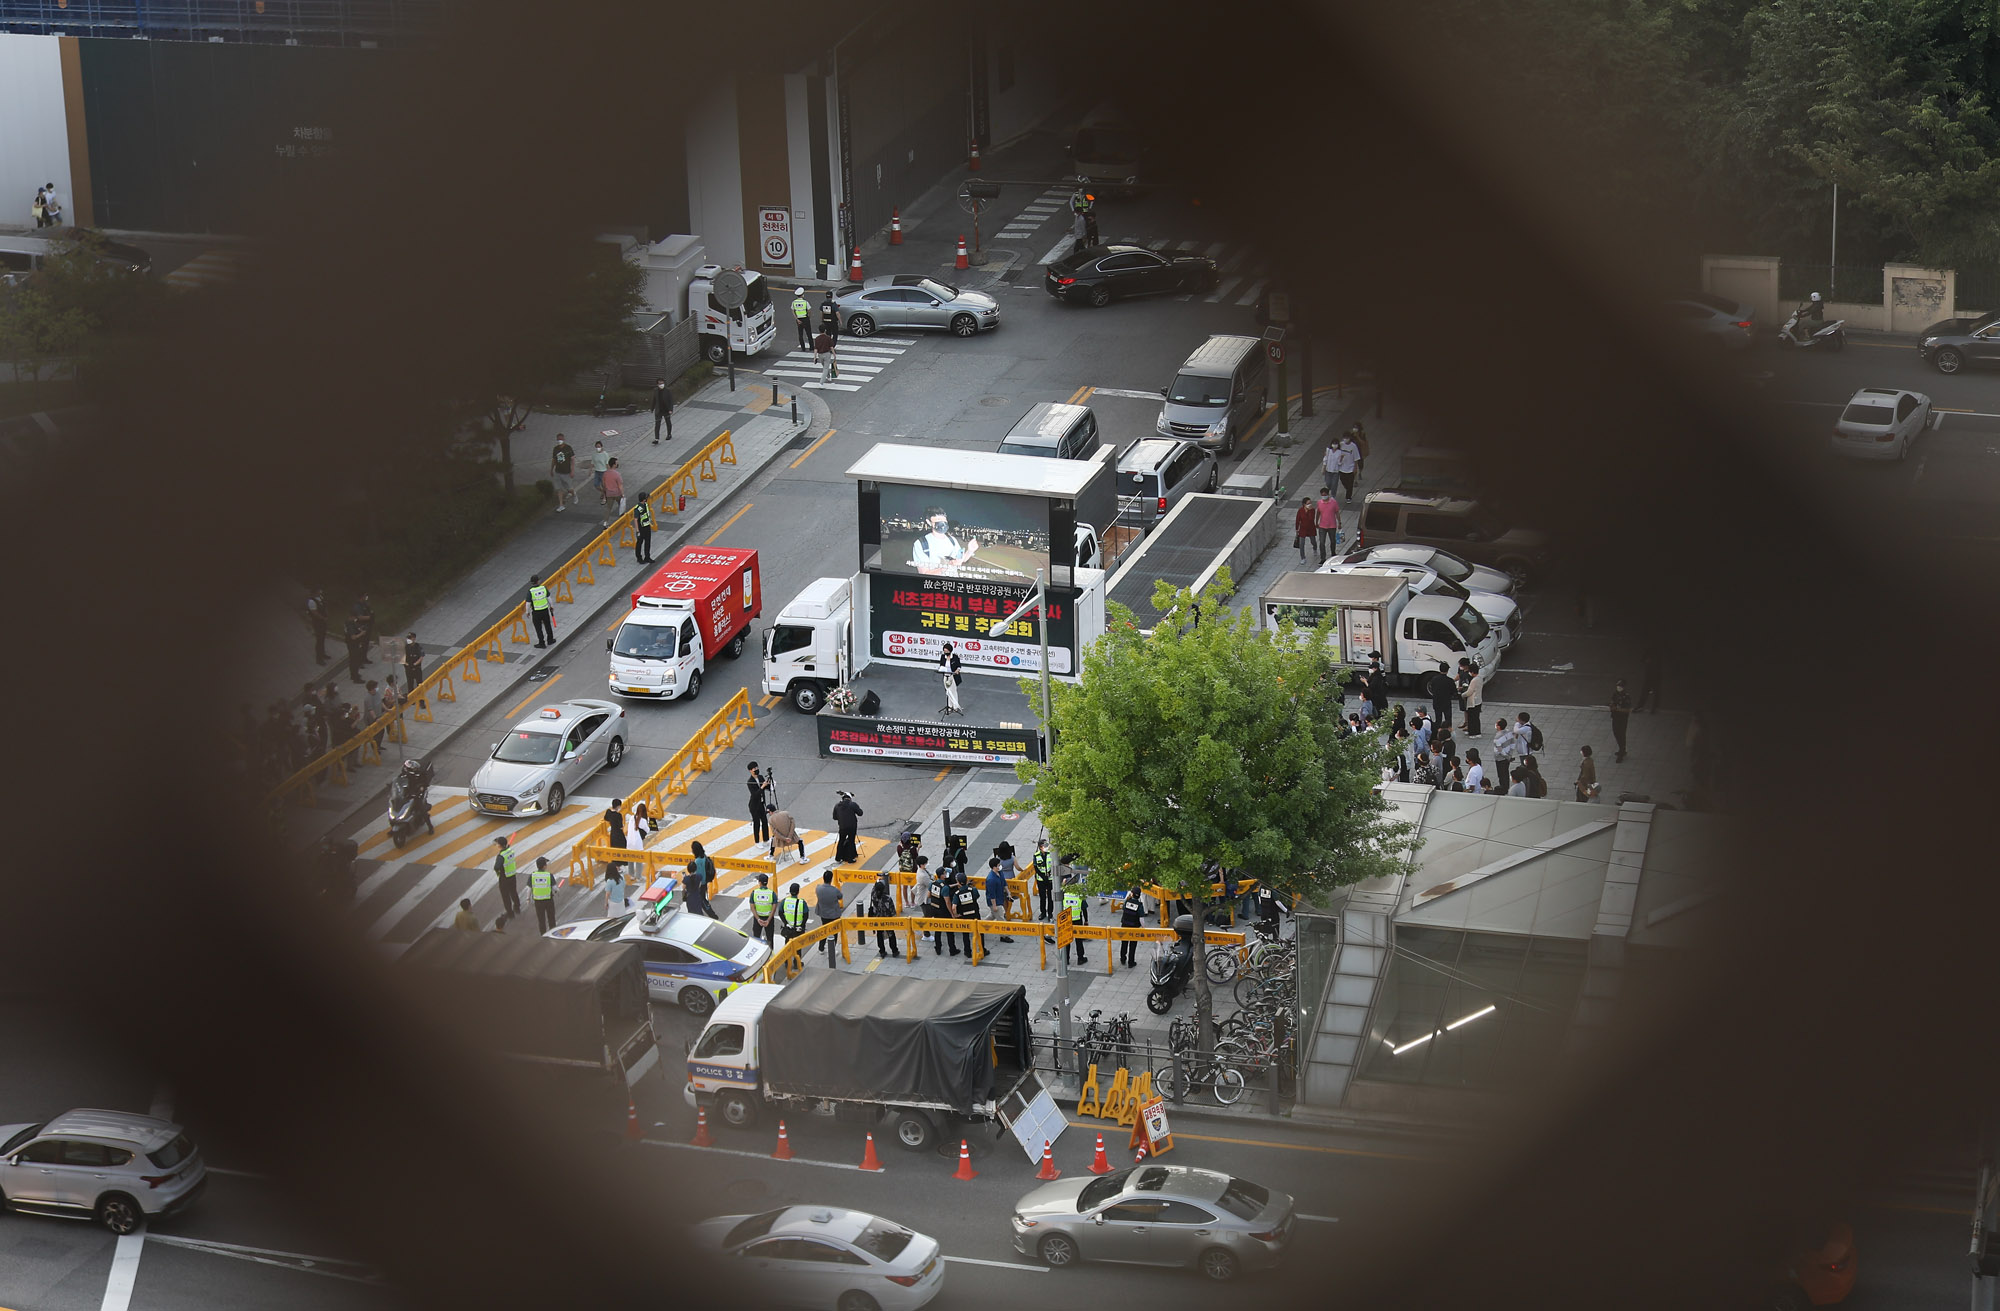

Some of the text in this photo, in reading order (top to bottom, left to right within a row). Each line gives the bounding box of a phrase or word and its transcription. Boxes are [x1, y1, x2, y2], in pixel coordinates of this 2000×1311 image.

[762, 222, 788, 232] 천천히
[770, 242, 782, 252] 10
[1270, 346, 1281, 359] 30
[957, 583, 965, 593] 군
[966, 583, 1011, 597] 반포한강공원
[1013, 588, 1029, 598] 사건
[892, 590, 963, 611] 서초경찰서
[968, 597, 997, 614] 부실
[920, 611, 950, 629] 규탄
[955, 615, 969, 632] 및
[907, 636, 919, 645] 6월
[908, 726, 916, 735] 군
[916, 727, 960, 738] 반포한강공원
[961, 730, 976, 739] 사건
[830, 730, 1026, 752] 서초경찰서 부실 초동수사 규탄 및 추모집회
[808, 927, 827, 940] POLICE
[647, 978, 675, 988] POLICE
[696, 1067, 723, 1076] POLICE
